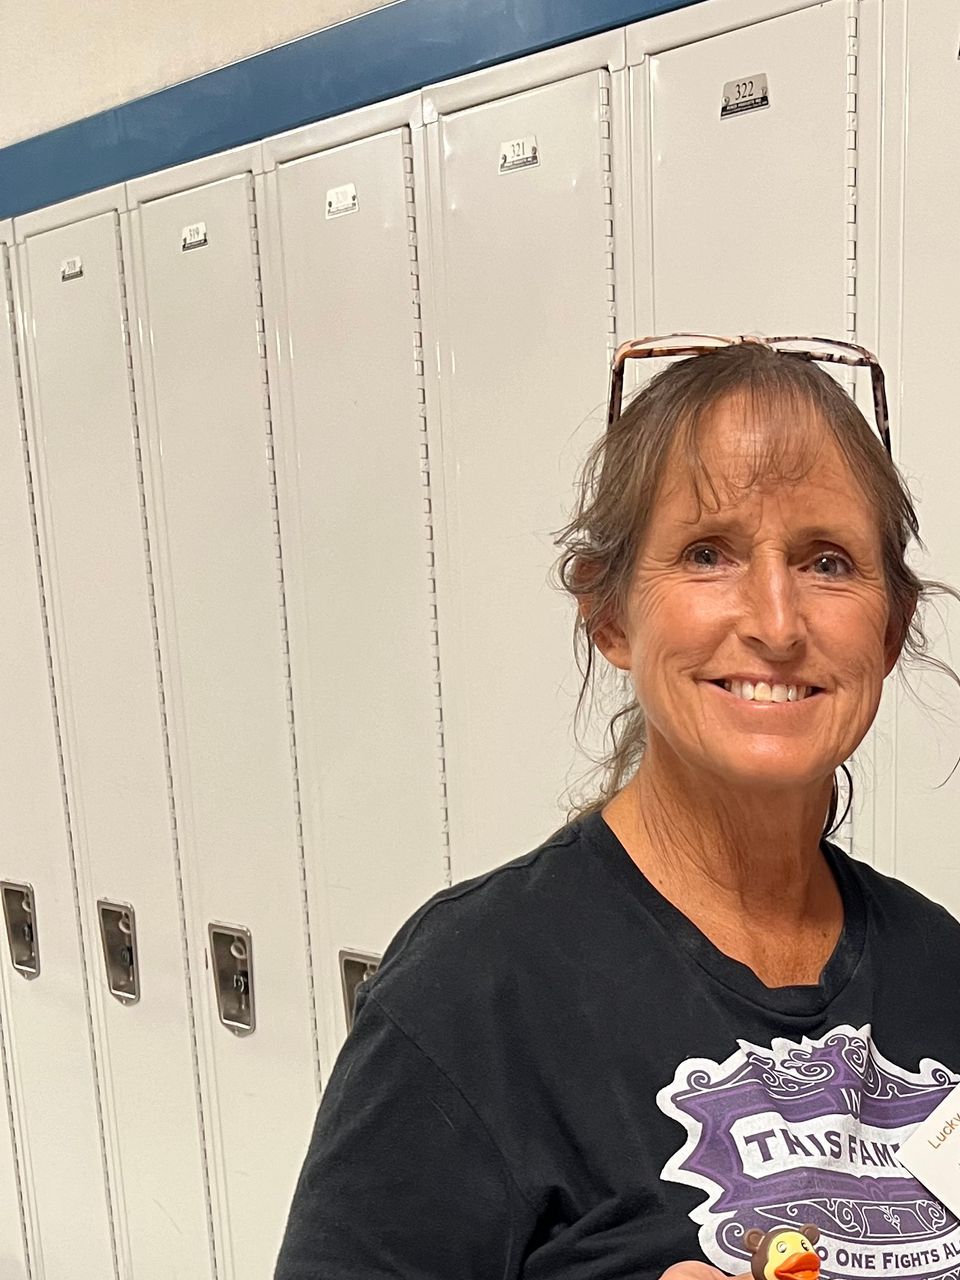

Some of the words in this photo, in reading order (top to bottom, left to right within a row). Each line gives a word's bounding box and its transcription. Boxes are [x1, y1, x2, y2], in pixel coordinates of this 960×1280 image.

[735, 80, 753, 100] 322
[511, 141, 525, 158] 321
[743, 1128, 842, 1163] THIS
[836, 1248, 876, 1270] ONE
[882, 1250, 940, 1270] FIGHTS
